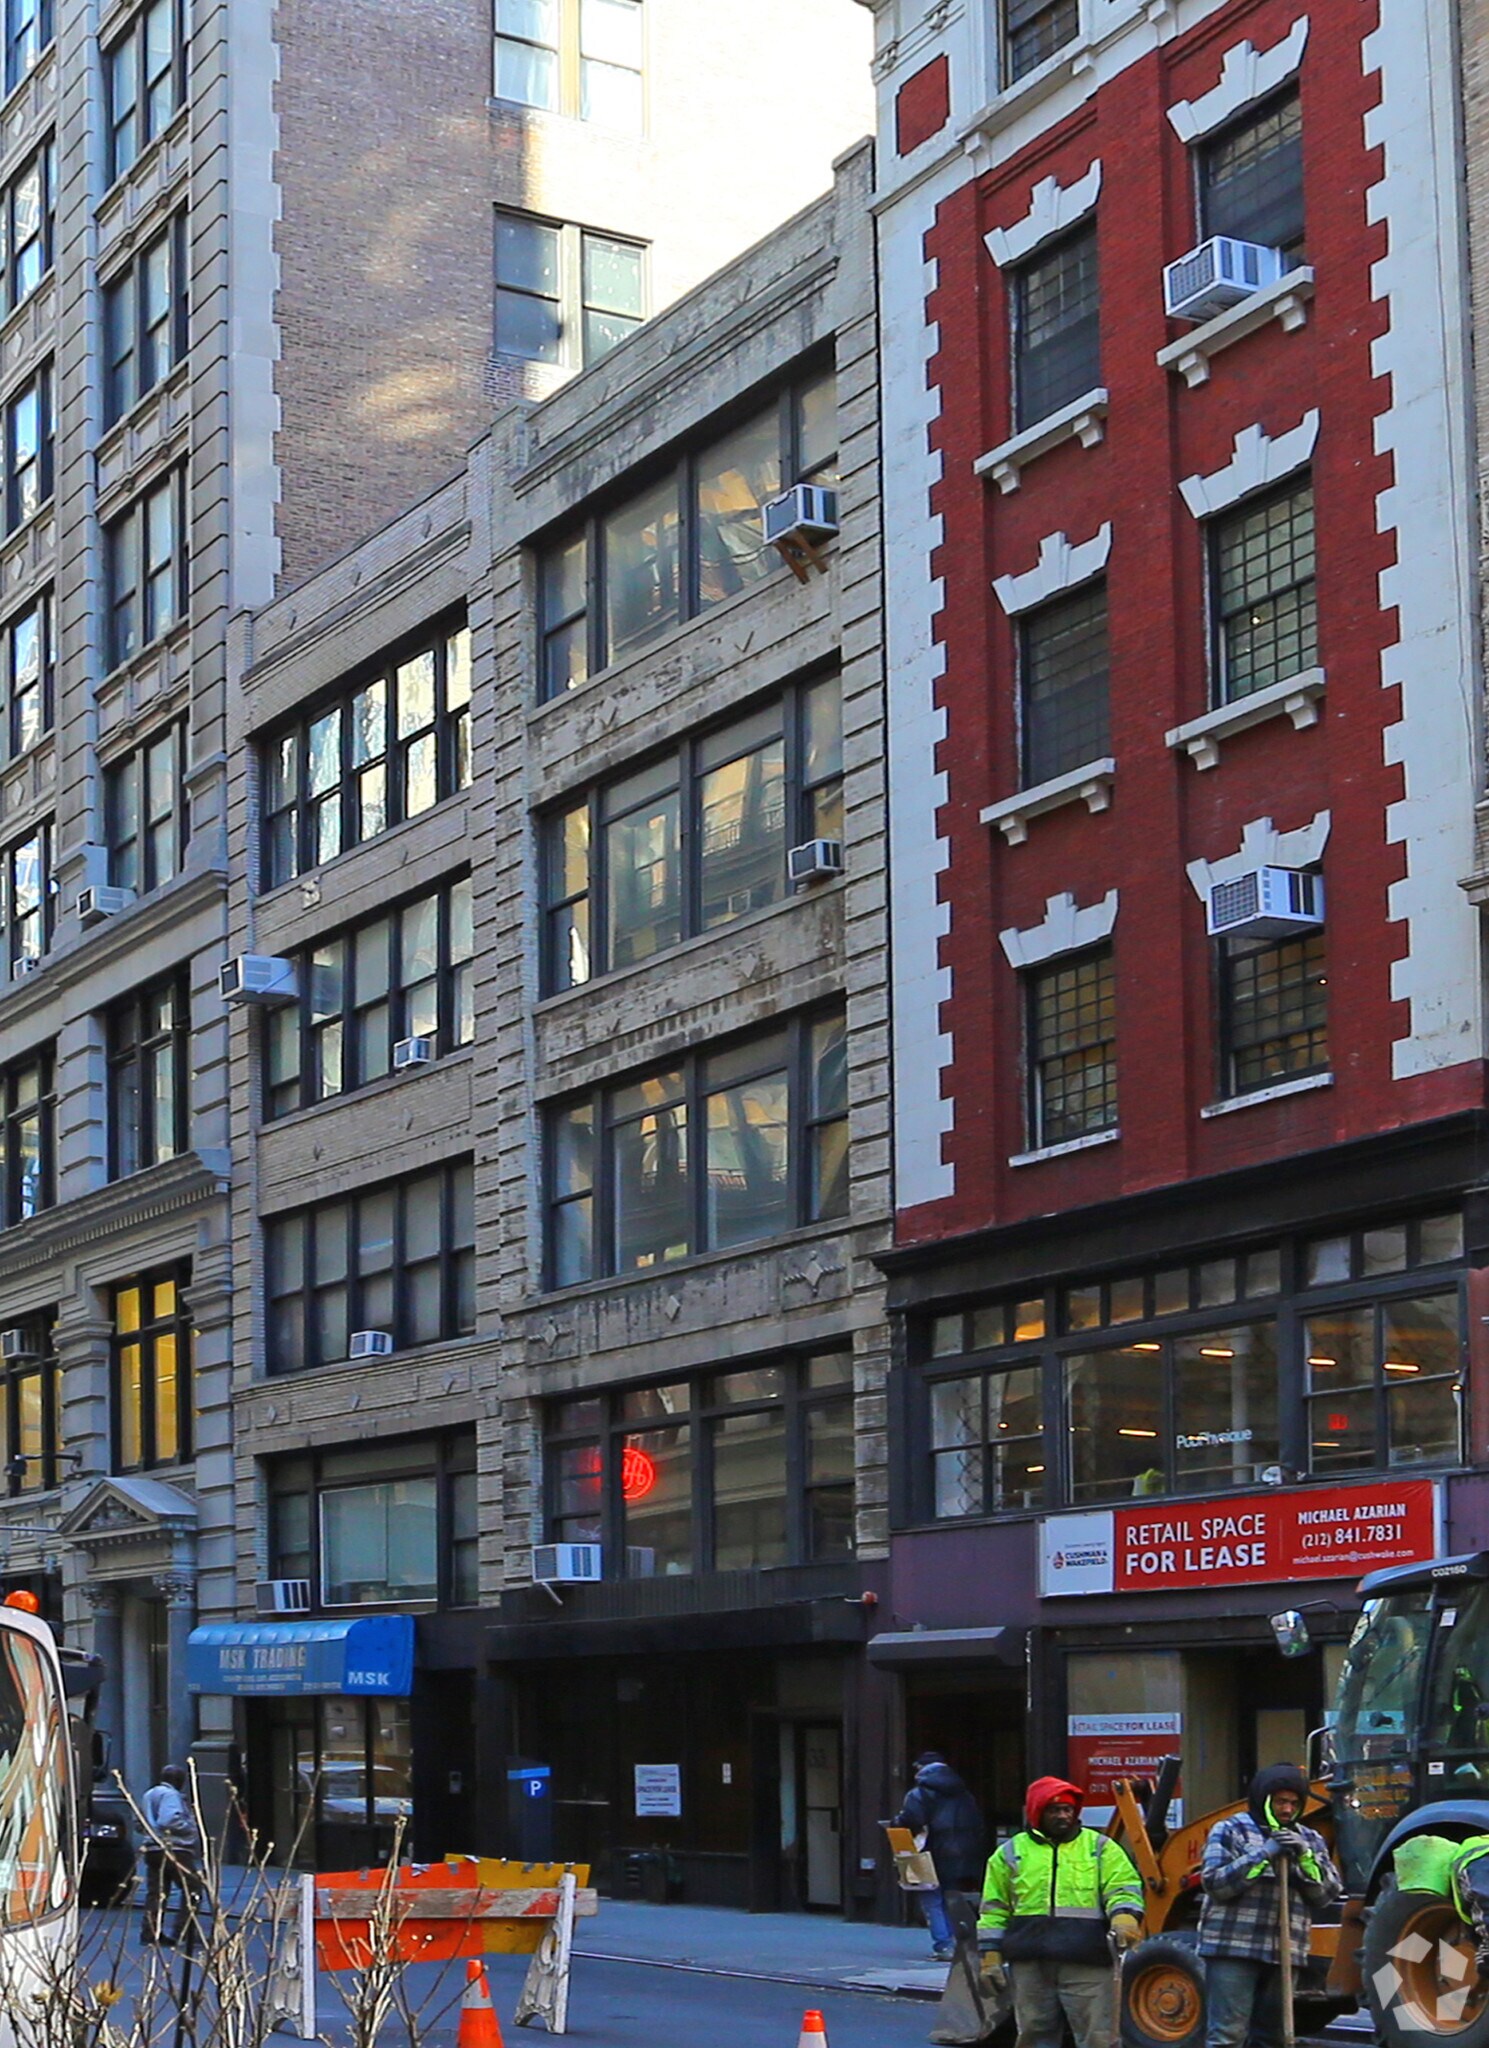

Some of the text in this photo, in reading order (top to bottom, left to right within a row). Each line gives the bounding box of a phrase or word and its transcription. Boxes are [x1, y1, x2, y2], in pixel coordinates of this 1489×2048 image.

[1297, 1503, 1406, 1525] MICHAEL AZARIAN
[1126, 1513, 1265, 1546] RETAIL SPACE
[1301, 1524, 1402, 1549] (212) 841.7831
[1126, 1541, 1266, 1577] FOR LEASE
[219, 1645, 307, 1670] MSK TRADING
[347, 1671, 391, 1687] MSK
[530, 1780, 542, 1797] P
